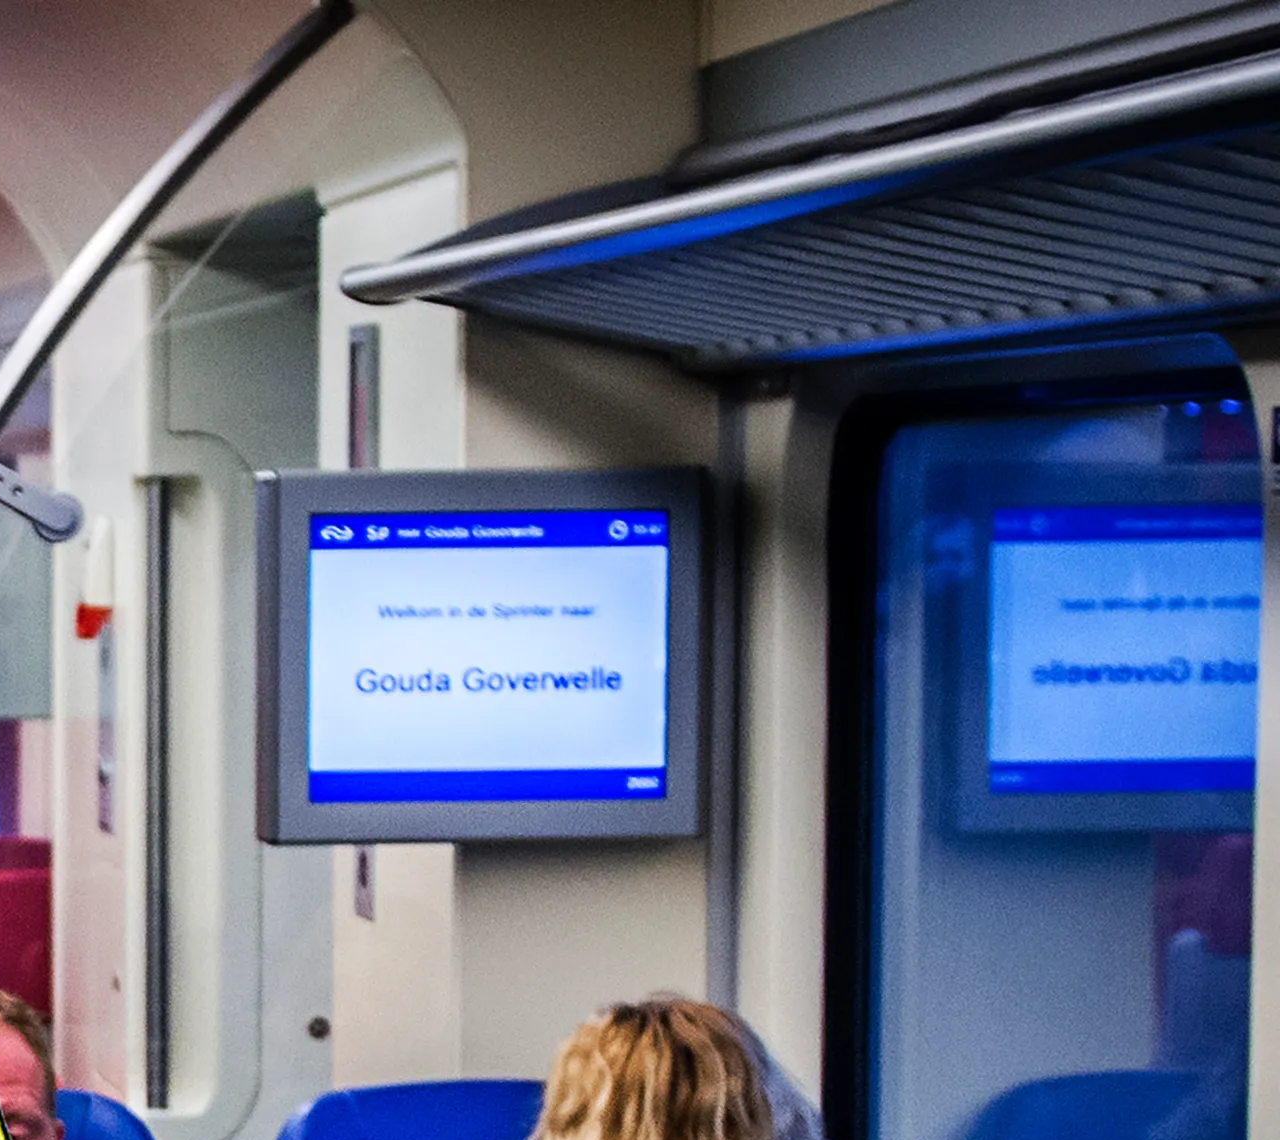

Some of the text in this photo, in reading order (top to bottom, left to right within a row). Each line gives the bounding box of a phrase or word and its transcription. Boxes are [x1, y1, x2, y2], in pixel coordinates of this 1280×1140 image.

[379, 604, 443, 618] Welkom
[448, 605, 462, 617] in
[467, 604, 487, 618] de
[492, 603, 554, 620] Sprinter
[355, 666, 624, 694] Gouda Goverwelle
